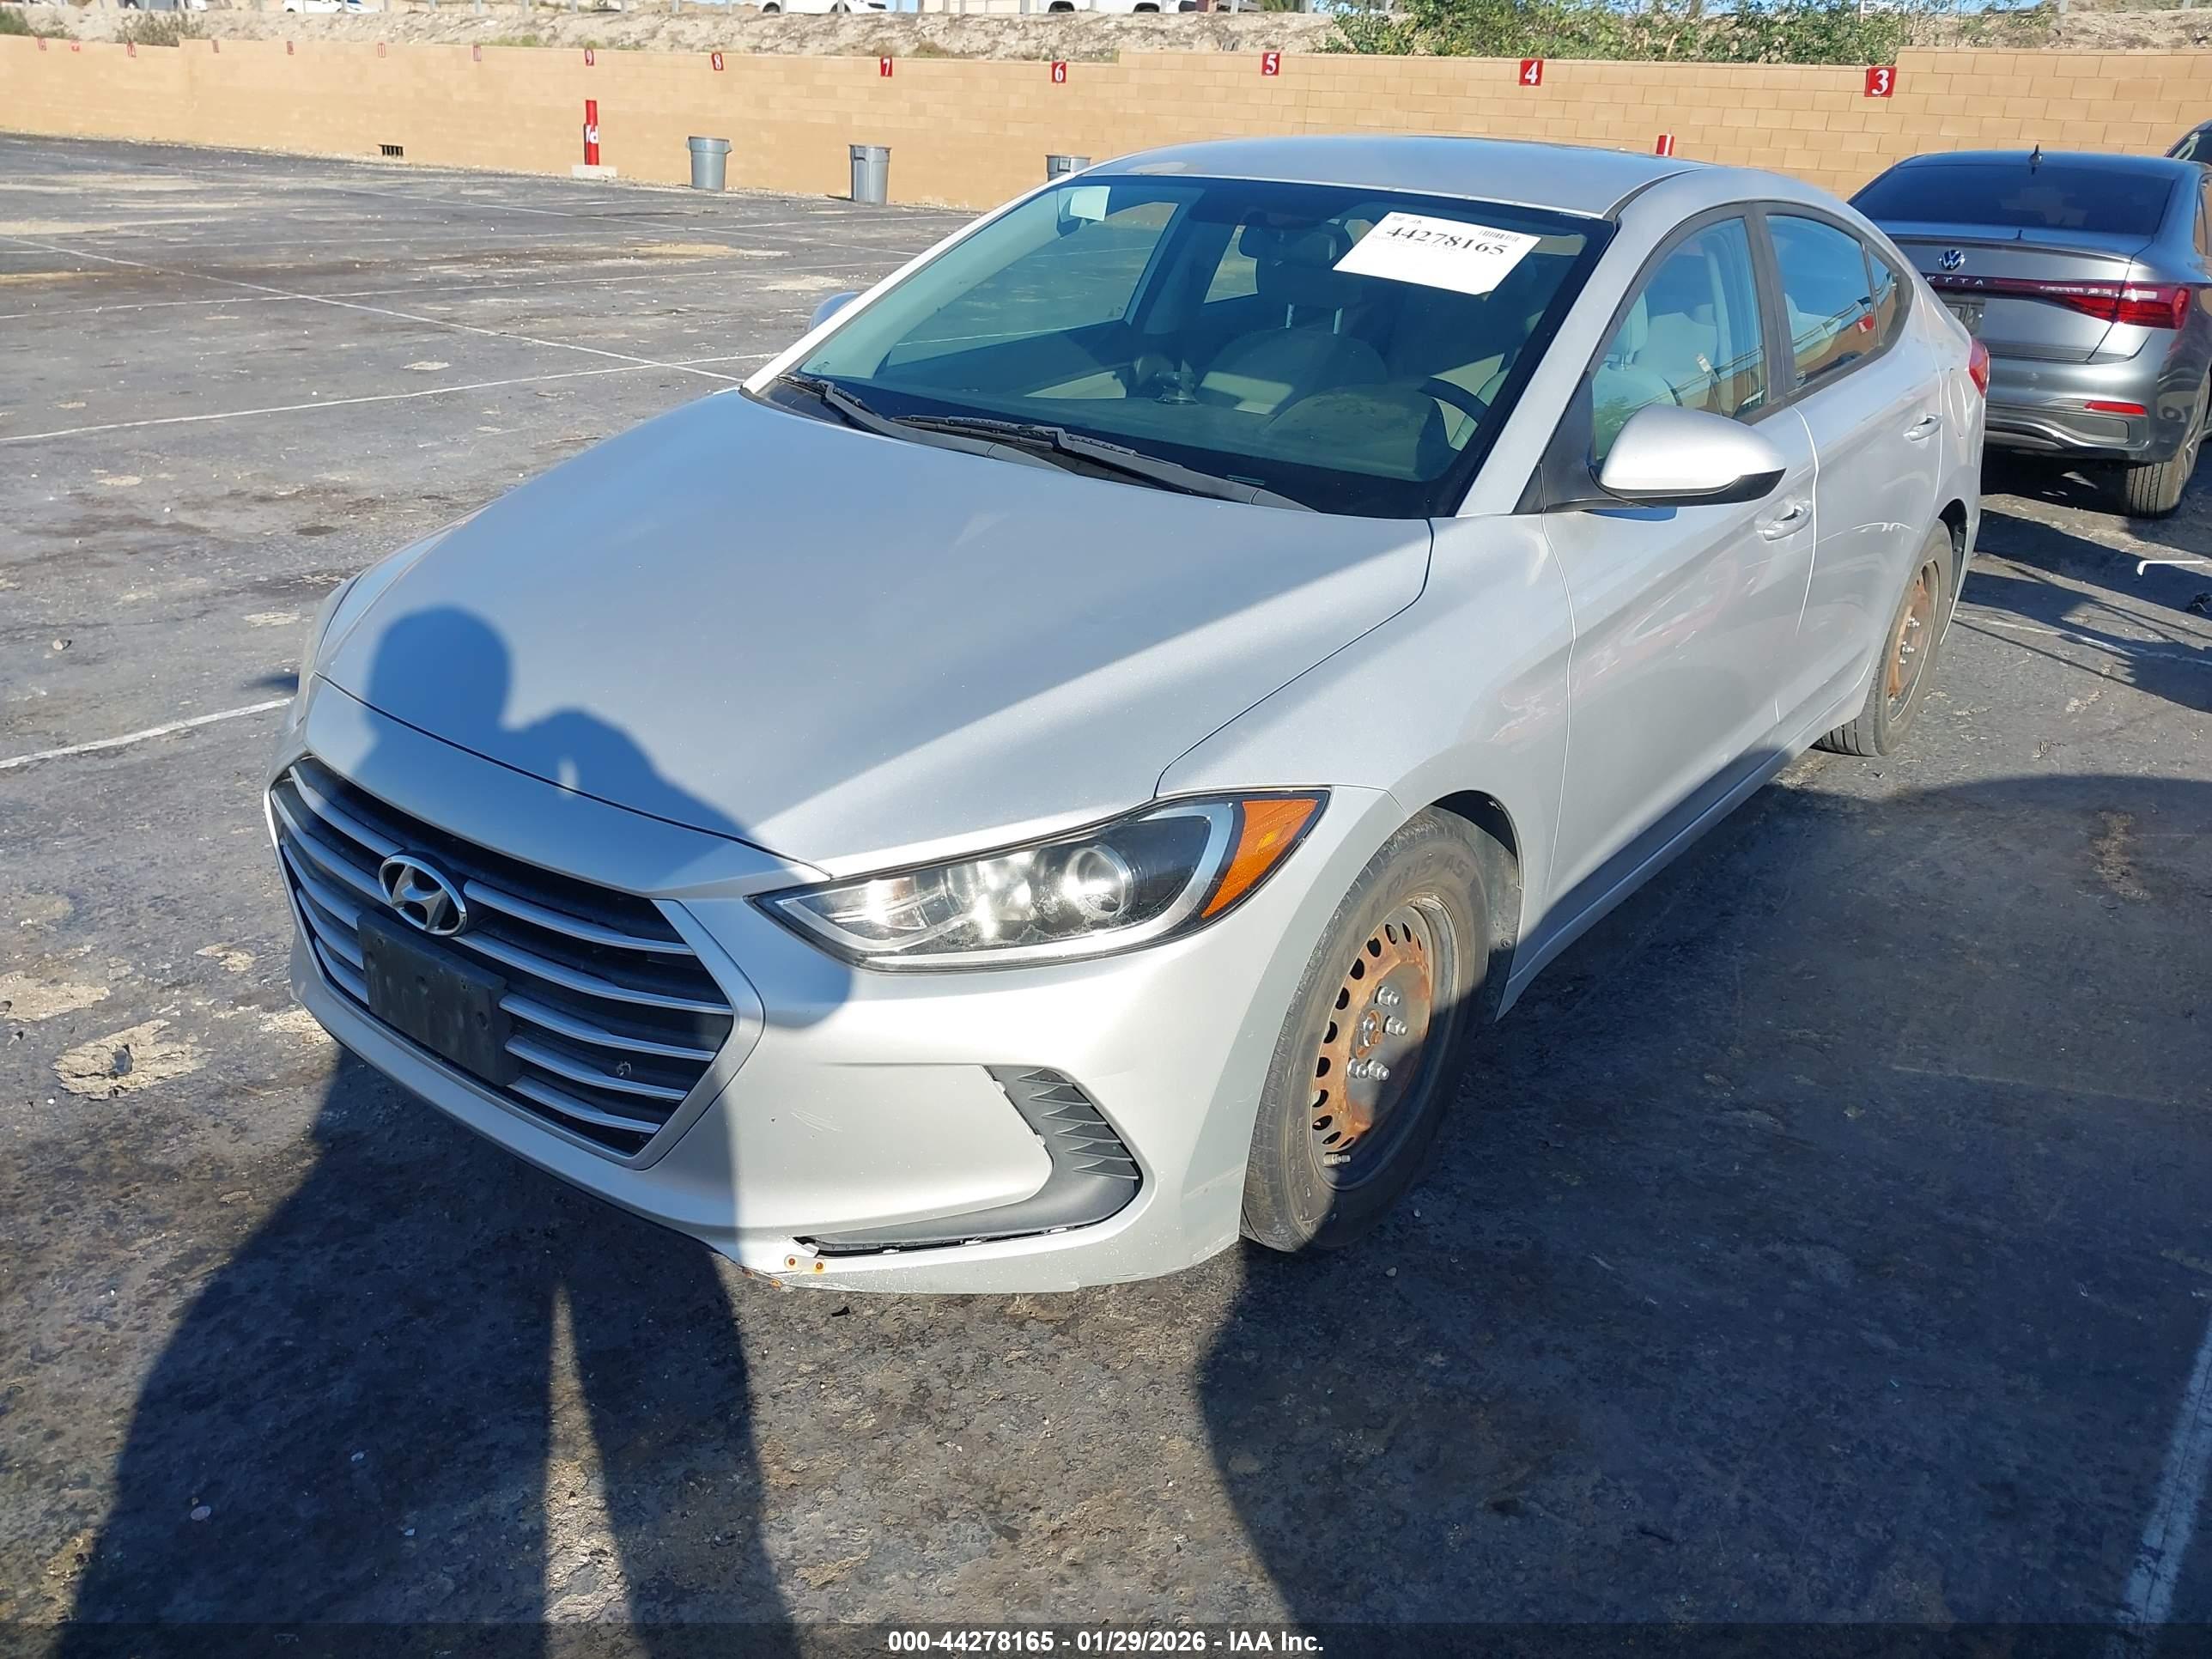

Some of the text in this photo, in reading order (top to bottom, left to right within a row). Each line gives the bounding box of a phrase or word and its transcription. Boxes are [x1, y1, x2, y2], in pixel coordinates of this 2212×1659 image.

[714, 54, 723, 70] 8
[883, 58, 891, 76] 7
[1265, 53, 1277, 75] 5
[1054, 64, 1064, 82] 6
[1523, 61, 1539, 84] 4
[1871, 70, 1889, 95] 3
[1386, 227, 1509, 256] 44278165
[1926, 276, 1984, 287] ETTA
